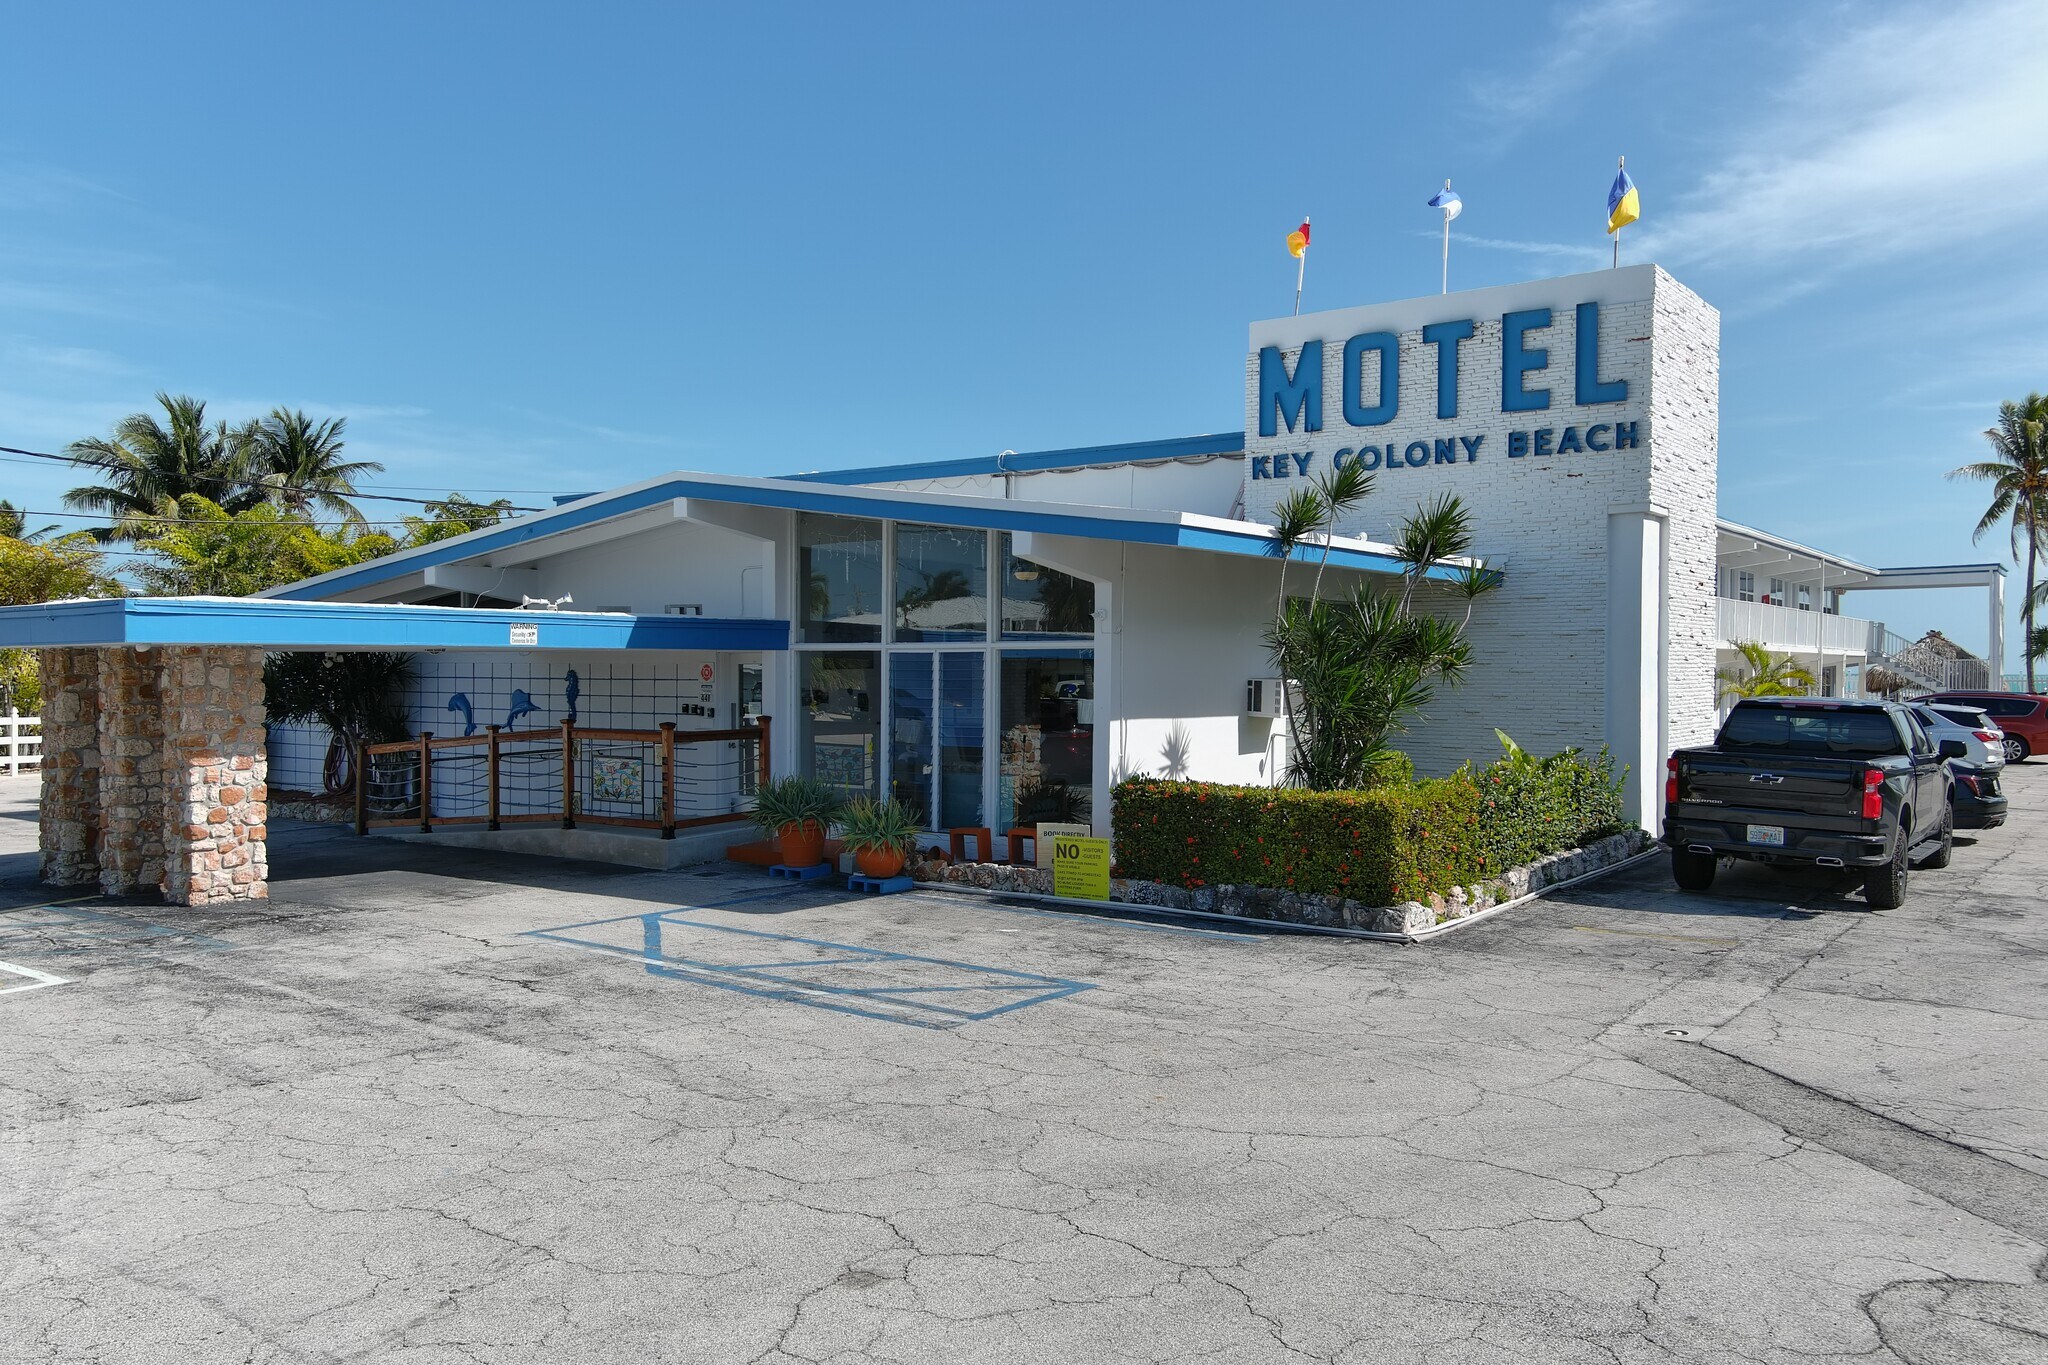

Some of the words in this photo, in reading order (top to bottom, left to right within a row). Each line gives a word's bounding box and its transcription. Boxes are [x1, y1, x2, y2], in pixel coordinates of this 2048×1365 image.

[1258, 301, 1629, 437] MOTEL
[1252, 451, 1314, 480] KEY
[1333, 434, 1485, 471] COLONY
[1508, 421, 1639, 459] BEACH
[1056, 843, 1080, 859] NO
